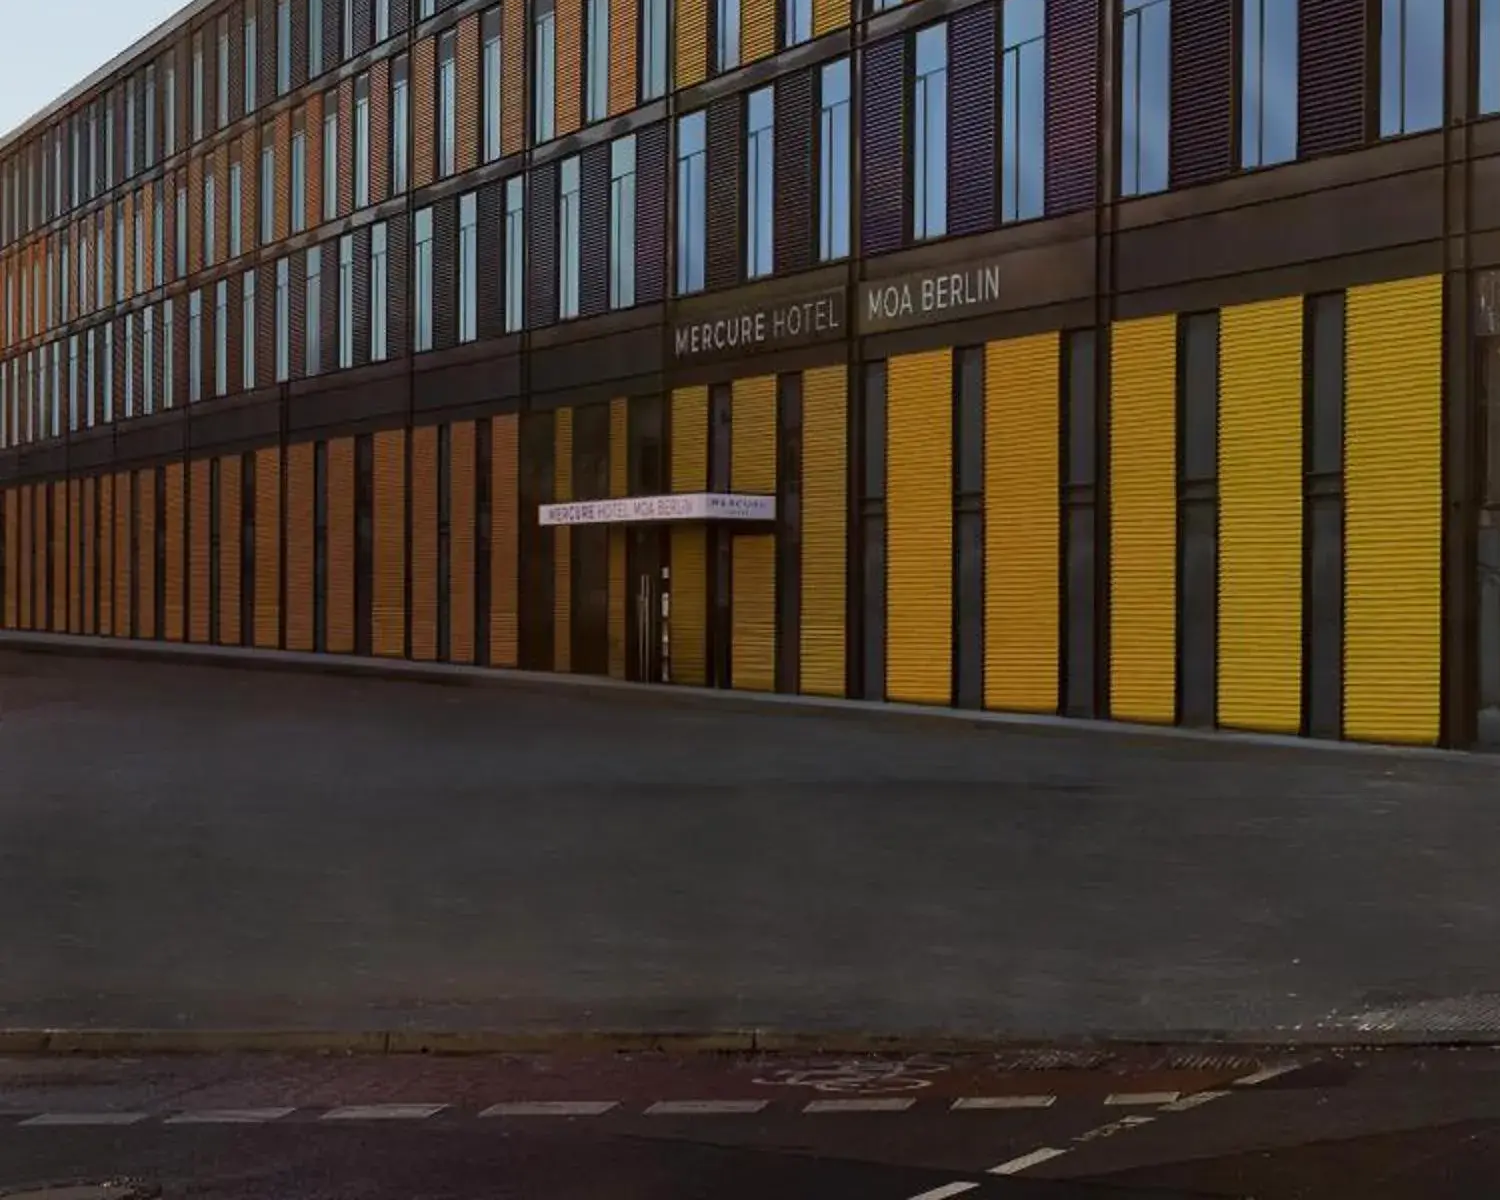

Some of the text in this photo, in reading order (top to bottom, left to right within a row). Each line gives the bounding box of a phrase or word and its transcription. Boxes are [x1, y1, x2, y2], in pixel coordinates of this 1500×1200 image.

[675, 264, 1000, 358] MERCURE HOTEL MOA BERLIN
[548, 497, 694, 522] MERCURE HOTEL MOA BERLIN
